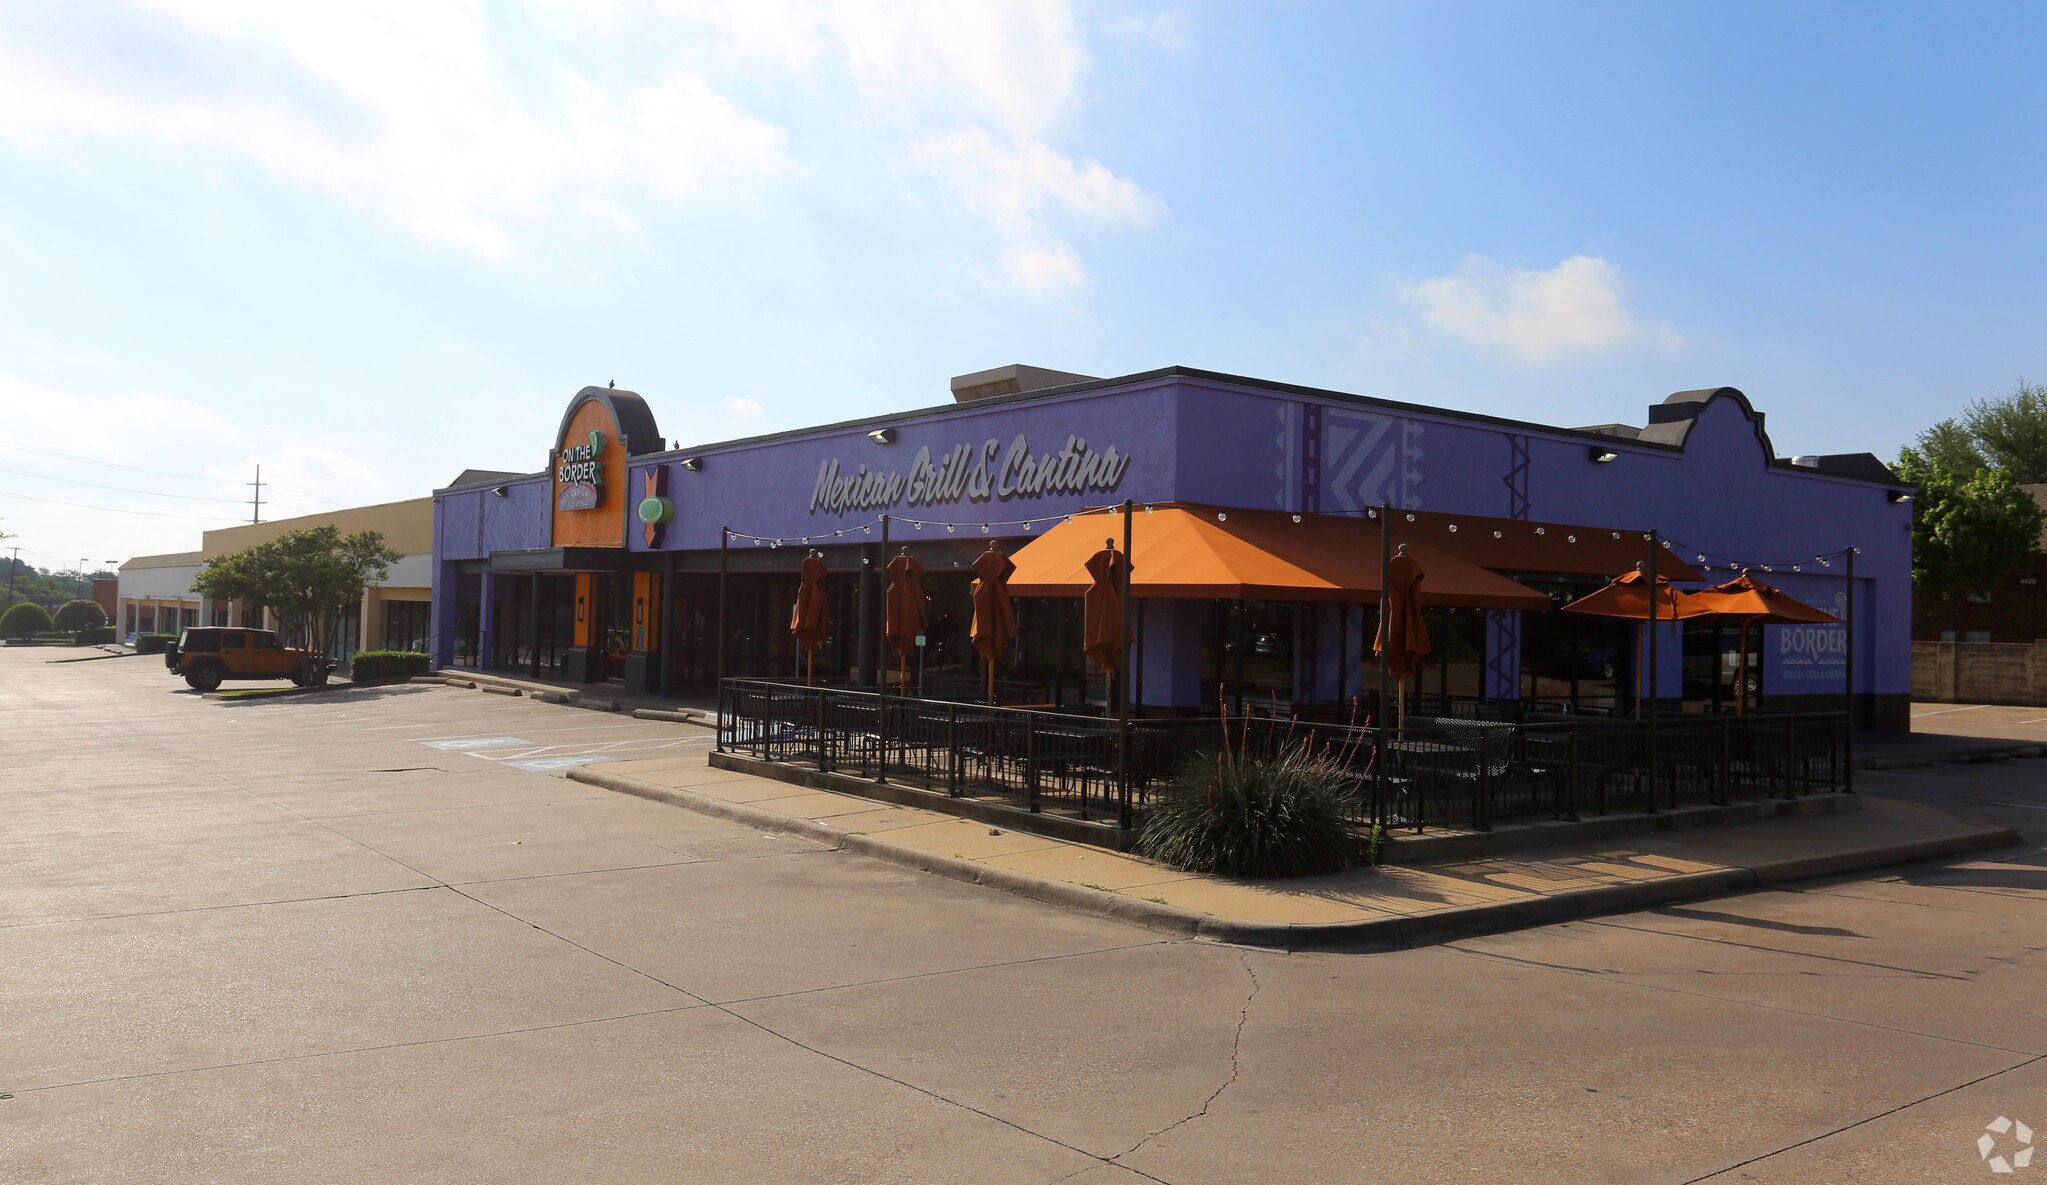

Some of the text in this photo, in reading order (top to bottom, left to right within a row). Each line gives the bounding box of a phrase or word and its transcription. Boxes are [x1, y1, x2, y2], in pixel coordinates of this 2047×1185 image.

[563, 445, 590, 463] ON THE
[559, 462, 596, 486] BORDER
[810, 433, 1130, 515] Mexican Grill & Cantina
[1781, 628, 1847, 661] BORDER
